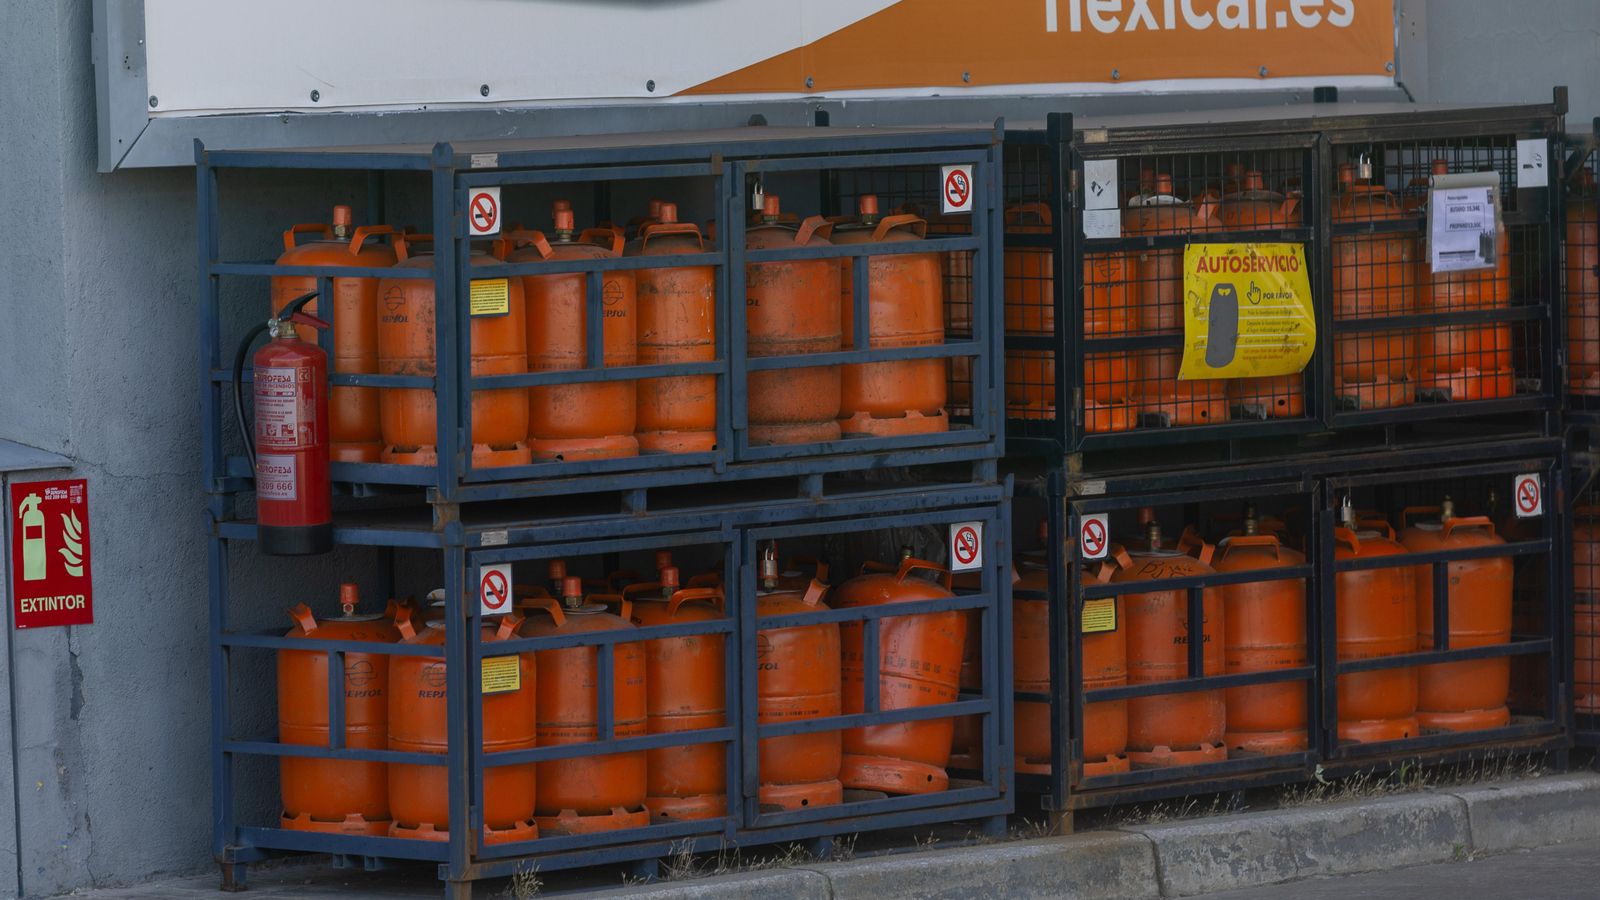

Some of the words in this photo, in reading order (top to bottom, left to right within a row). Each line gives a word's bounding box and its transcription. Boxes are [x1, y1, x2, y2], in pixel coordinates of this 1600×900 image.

[1196, 255, 1299, 273] AUTOSERVICIO
[21, 594, 85, 613] EXTINTOR
[344, 688, 384, 698] EPSOL
